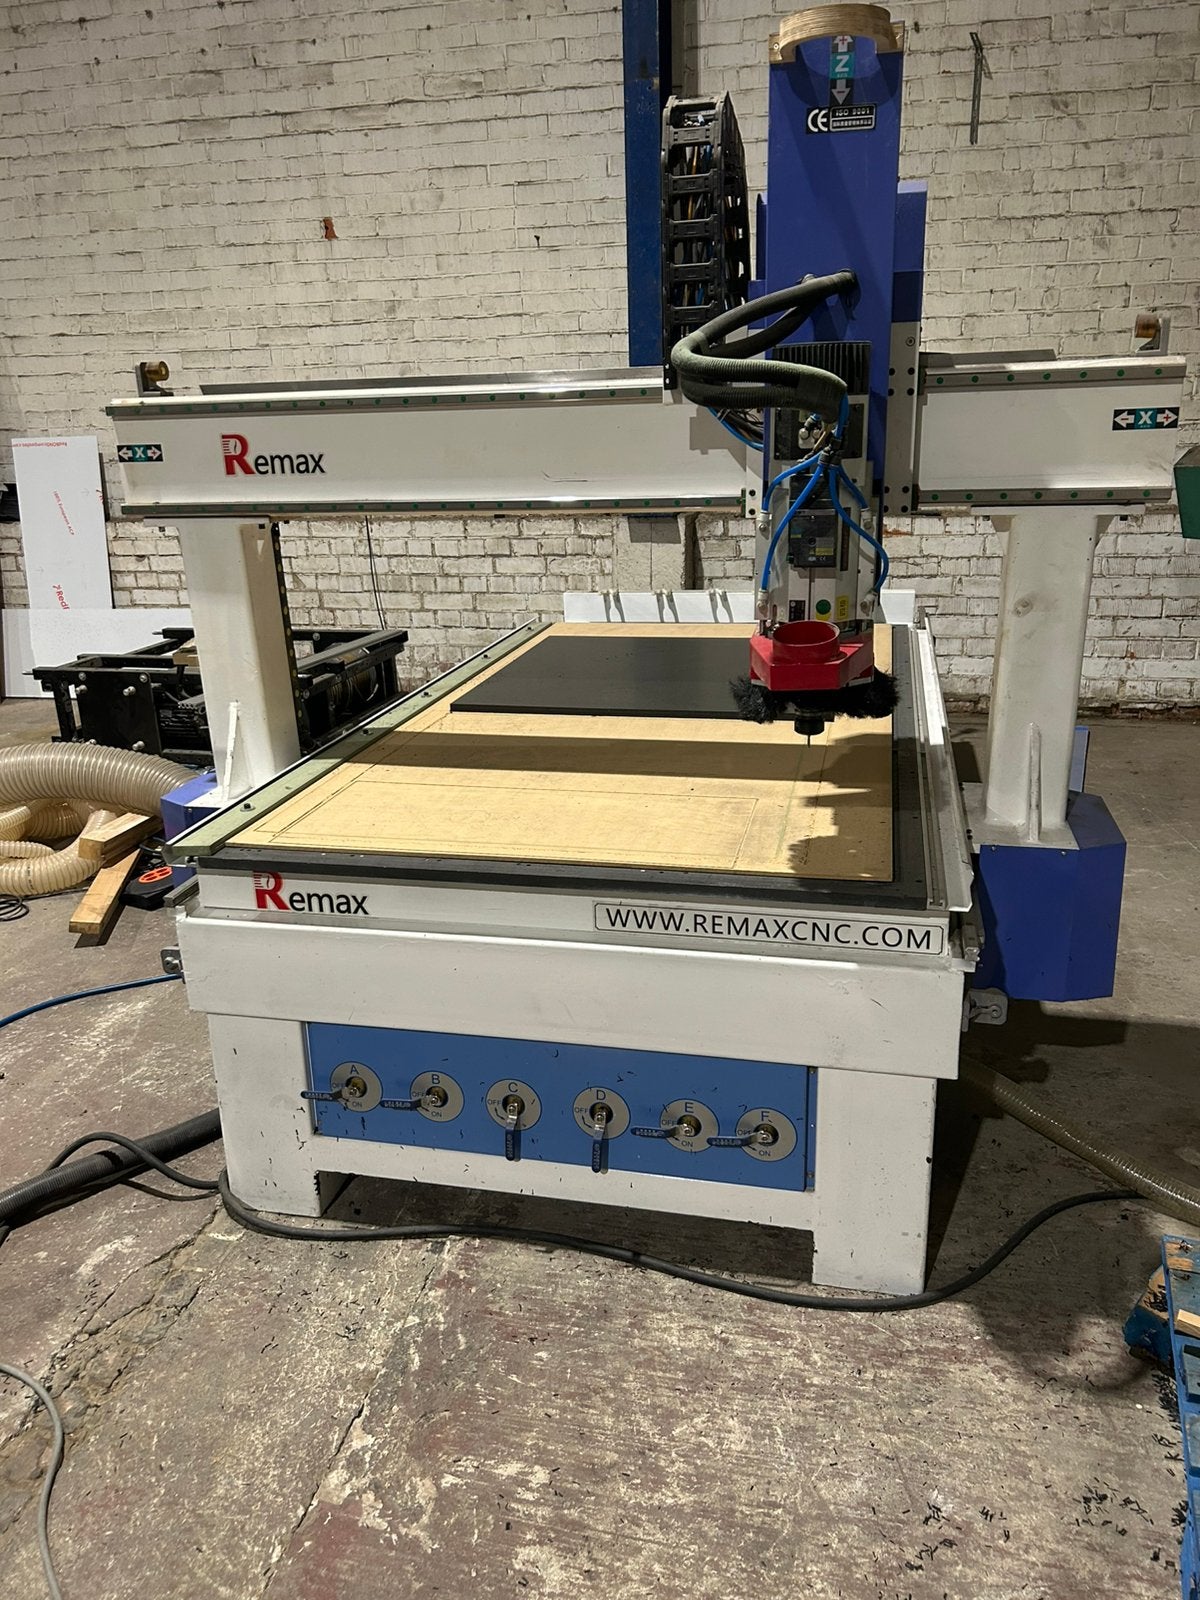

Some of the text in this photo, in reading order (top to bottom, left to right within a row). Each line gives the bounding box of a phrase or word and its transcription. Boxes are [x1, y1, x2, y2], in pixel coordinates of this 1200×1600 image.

[834, 54, 849, 72] Z
[835, 109, 849, 117] ISO
[807, 108, 829, 132] CE
[1138, 410, 1154, 425] X
[134, 446, 146, 459] X
[221, 433, 325, 476] Remax
[252, 869, 370, 915] Remax
[605, 907, 932, 950] WWW.REMAXCNC.COM
[350, 1064, 360, 1075] A
[431, 1073, 441, 1085] B
[508, 1082, 519, 1093] C
[596, 1089, 607, 1101] D
[574, 1106, 589, 1114] OFF
[684, 1101, 694, 1113] E
[430, 1110, 443, 1118] ON
[760, 1110, 770, 1122] F
[681, 1140, 694, 1148] ON
[758, 1149, 771, 1157] ON
